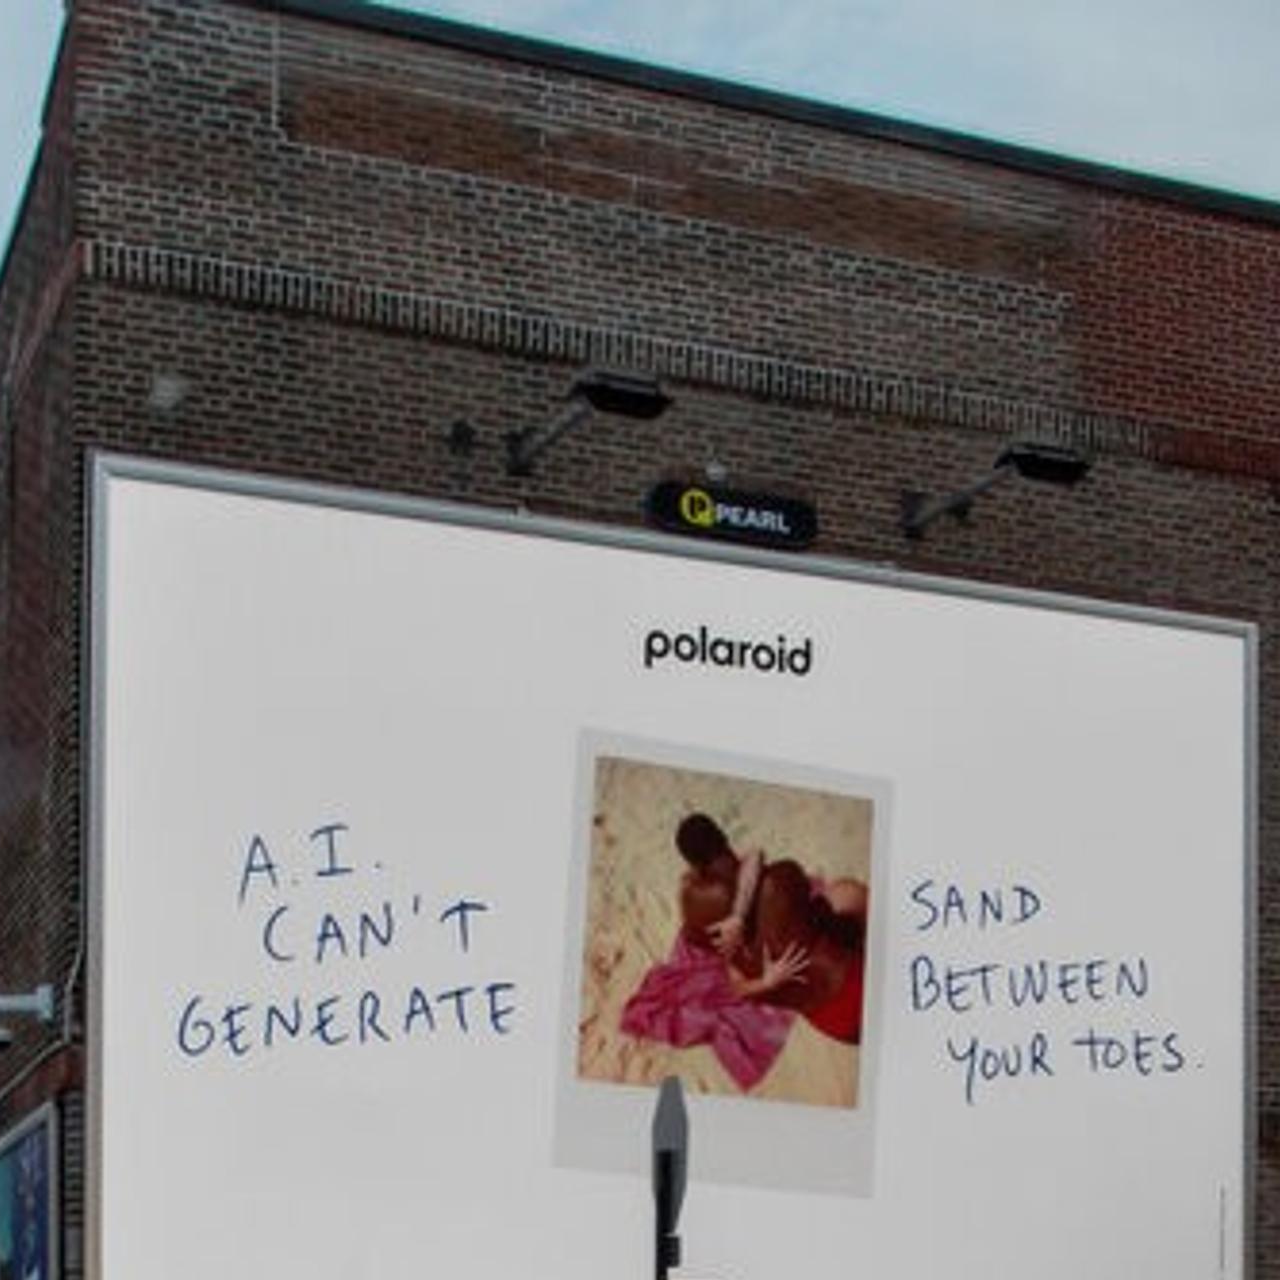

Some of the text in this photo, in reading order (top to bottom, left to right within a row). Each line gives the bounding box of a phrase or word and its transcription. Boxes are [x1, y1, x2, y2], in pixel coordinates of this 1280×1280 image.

[716, 503, 791, 535] PEARL
[644, 625, 812, 676] polaroid
[239, 823, 382, 902] A.I.
[263, 895, 488, 964] CAN'T
[911, 880, 1042, 930] SAND
[911, 955, 1148, 1012] BETWEEN
[178, 983, 515, 1056] GENERATE
[947, 1029, 1204, 1105] YOUR TOES.
